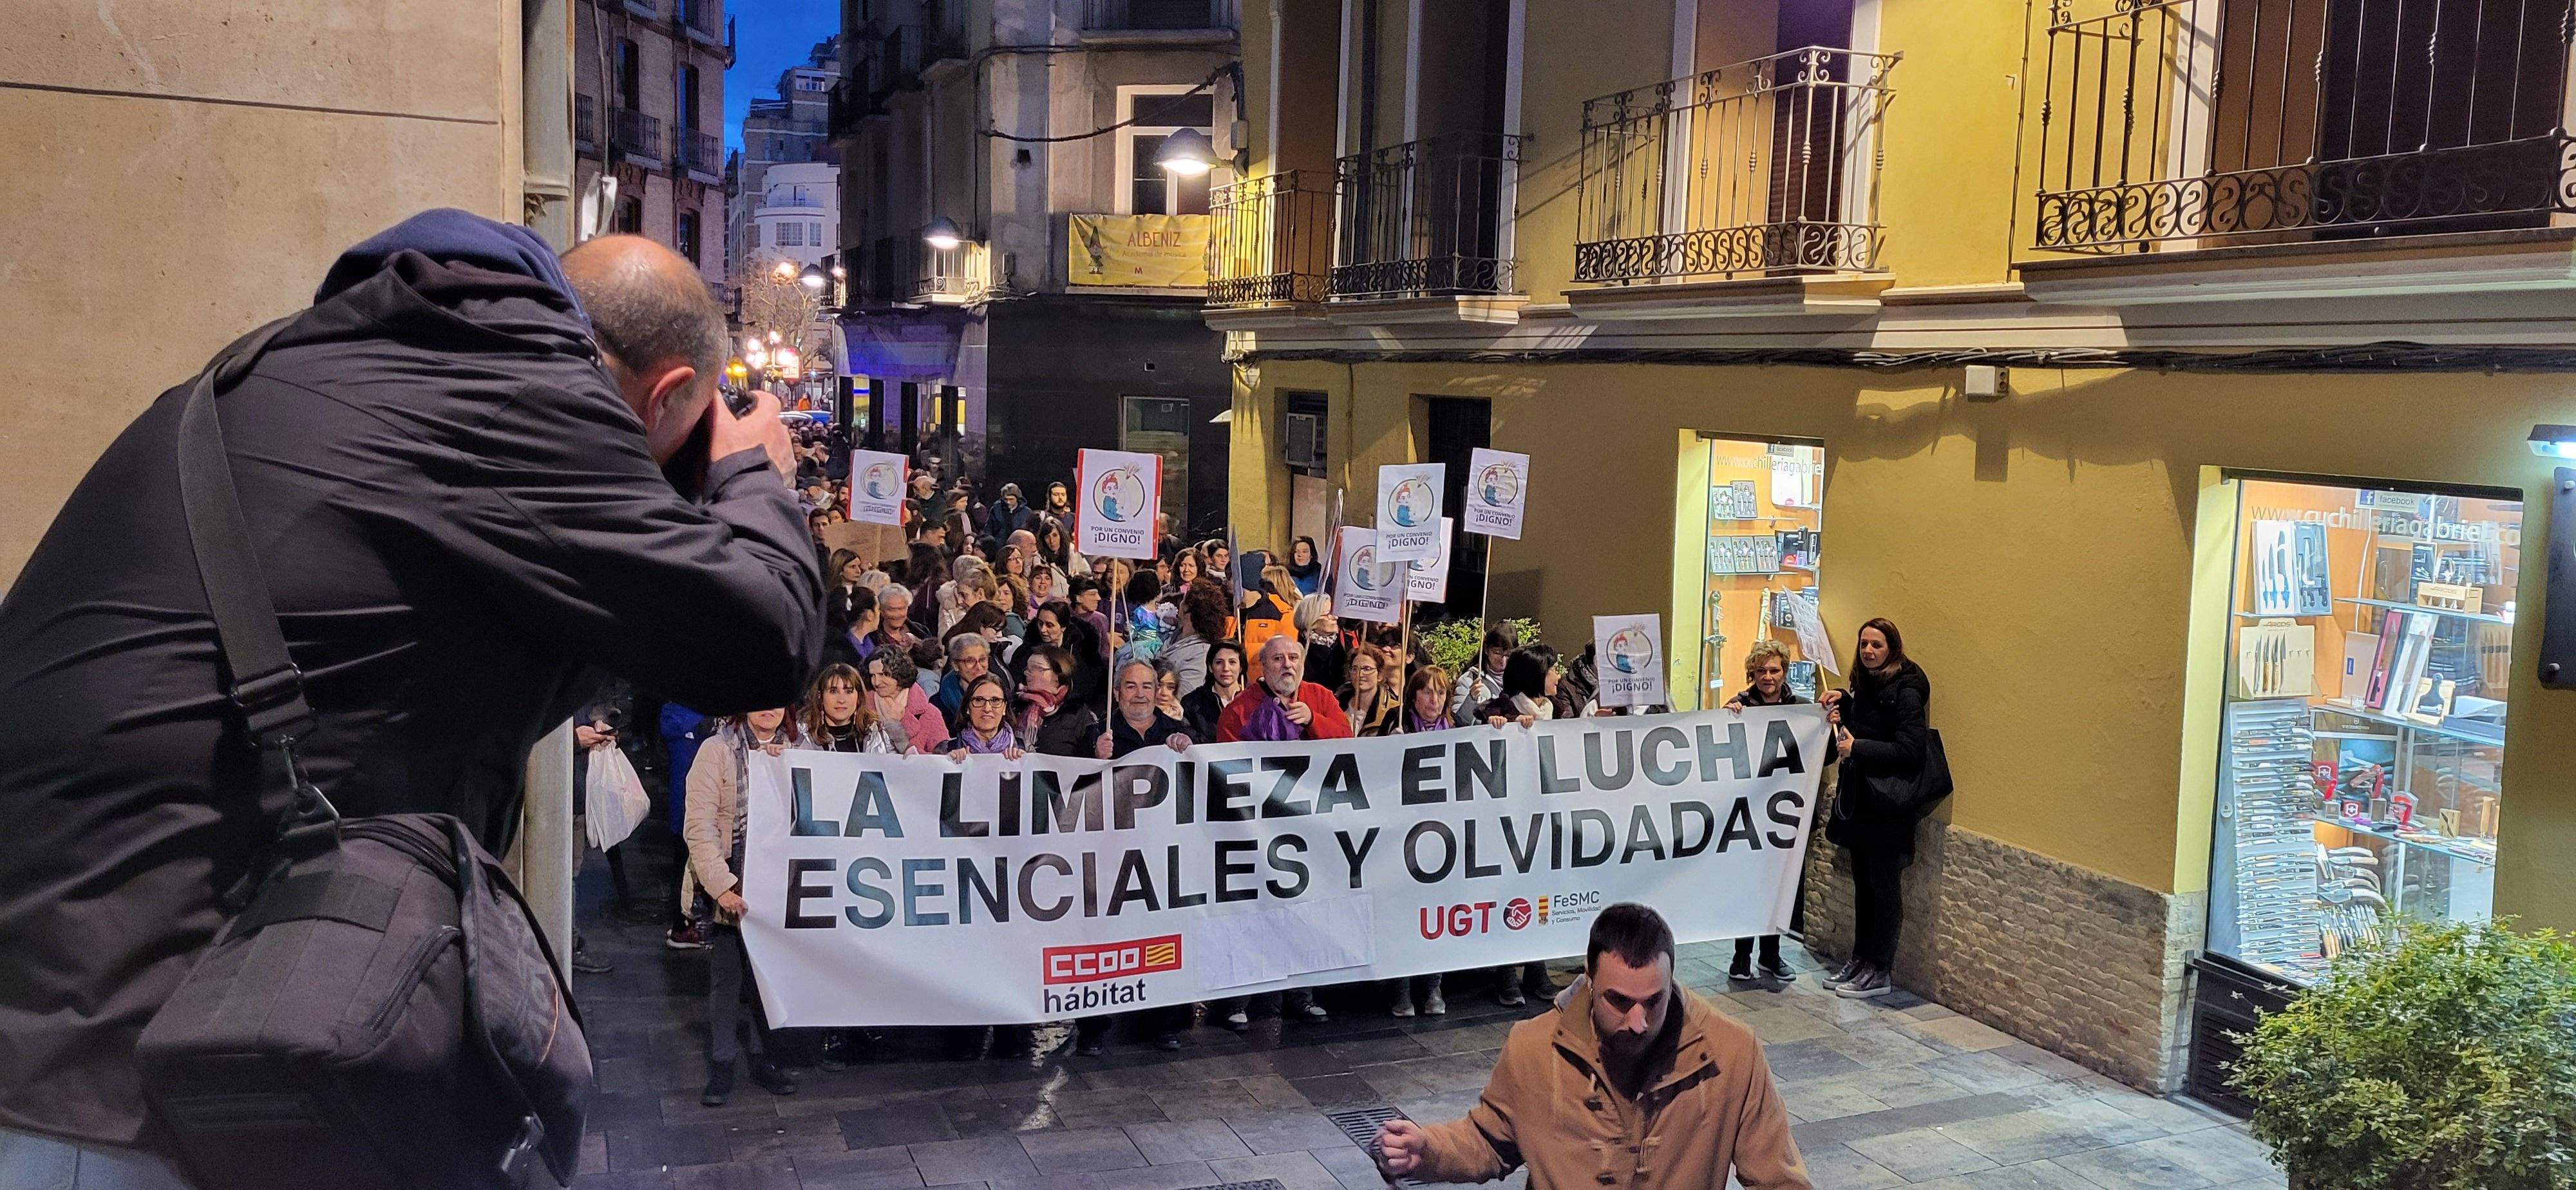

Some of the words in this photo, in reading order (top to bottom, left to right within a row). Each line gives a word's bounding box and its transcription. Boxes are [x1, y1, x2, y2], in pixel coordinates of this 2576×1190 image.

[2380, 495, 2415, 505] facebook
[1475, 514, 1512, 527] ¡DIGNO!
[1492, 511, 1516, 519] CONVENIO
[1094, 532, 1141, 544] ¡DIGNO!
[1388, 536, 1429, 549] ¡DIGNO!
[1612, 681, 1653, 694] ¡DIGNO!
[791, 767, 904, 838] LA
[940, 754, 1370, 838] LIMPIEZA
[1401, 739, 1507, 806] EN
[1537, 719, 1806, 795] LUCHA
[784, 832, 1310, 930] ESENCIALES
[1333, 826, 1380, 889] Y
[1403, 789, 1806, 885] OLVIDADAS
[1554, 891, 1600, 908] FeSMC
[1420, 901, 1497, 940] UGT
[1050, 947, 1140, 978] CCOO
[1043, 978, 1146, 1014] hábitat
